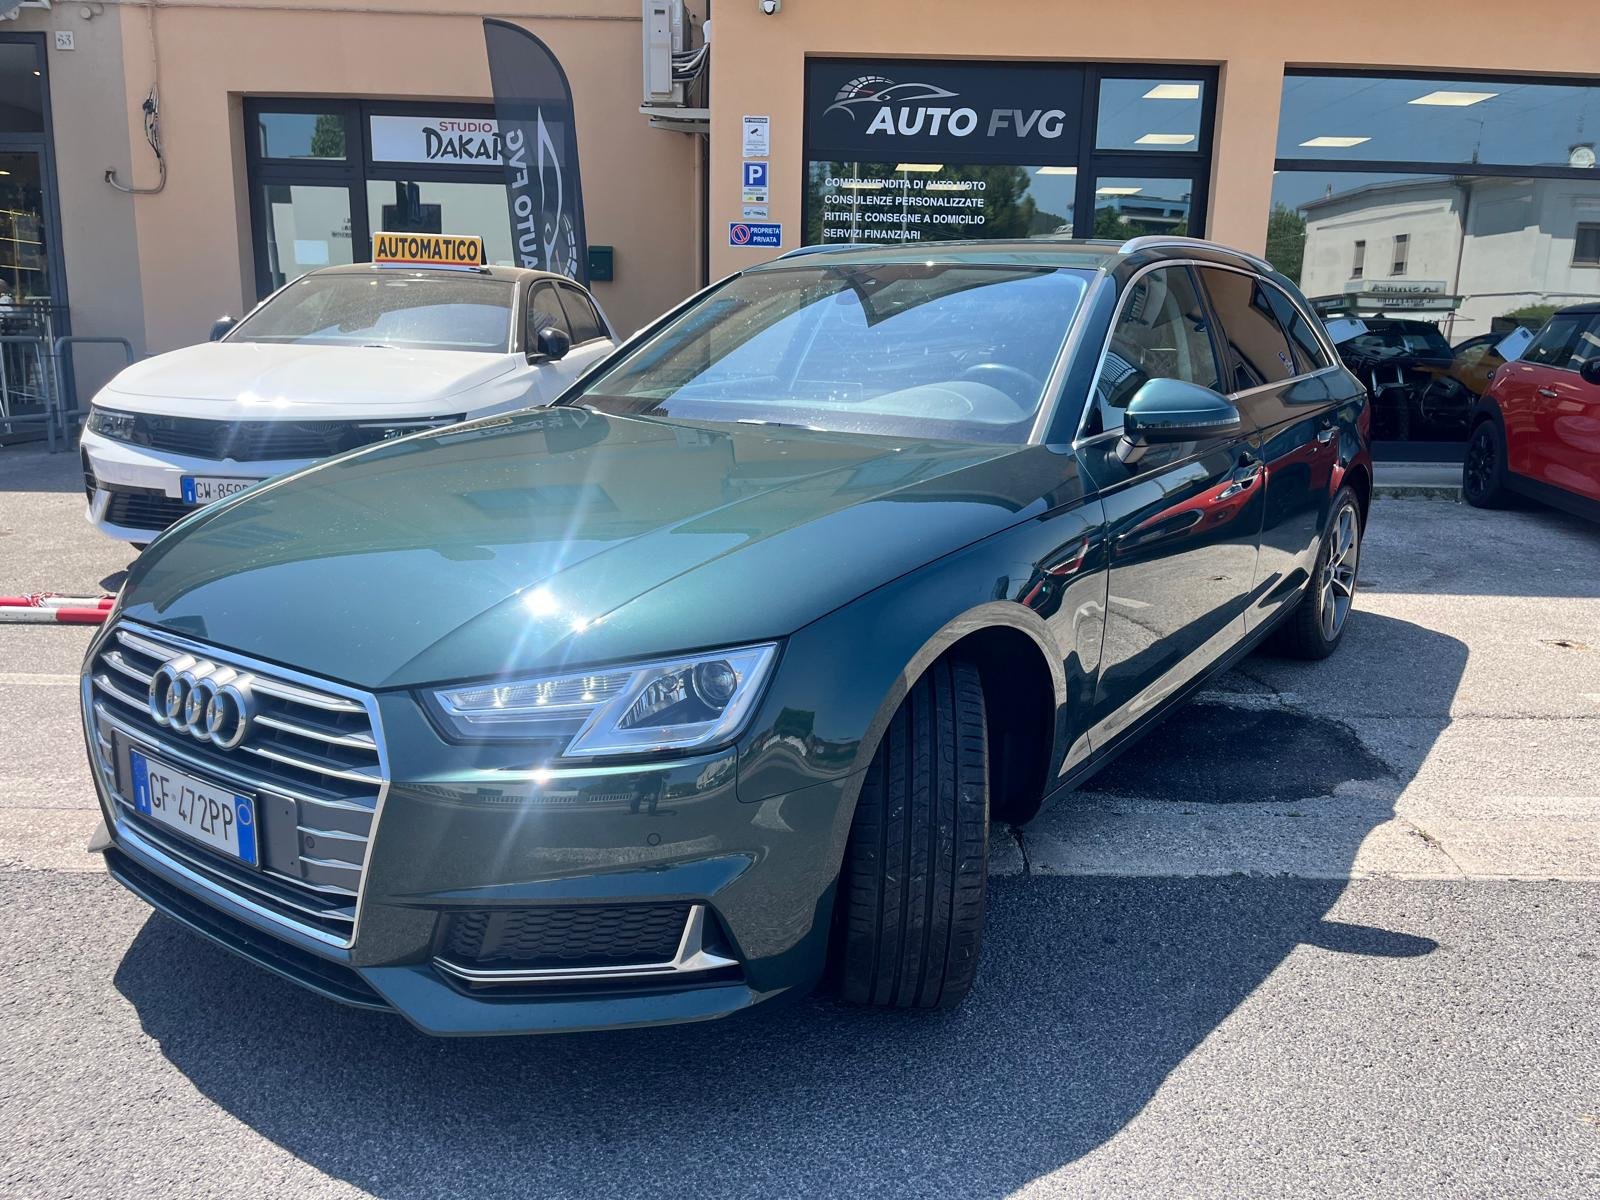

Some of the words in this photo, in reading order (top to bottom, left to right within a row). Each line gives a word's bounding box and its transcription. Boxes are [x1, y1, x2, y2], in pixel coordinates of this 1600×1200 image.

[439, 121, 493, 133] STUDIO
[866, 106, 978, 137] AUTO
[986, 109, 1066, 139] FVG
[749, 165, 763, 184] P
[825, 177, 911, 189] COMPRAVENDITA
[913, 179, 924, 189] DI
[956, 181, 986, 191] MOTO
[824, 195, 893, 205] CONSULENZE
[895, 196, 985, 208] PERSONALIZZATE
[824, 212, 853, 221] RITIRI
[855, 212, 863, 221] E
[864, 212, 922, 223] CONSEGNE
[923, 214, 931, 223] A
[933, 214, 985, 225] DOMICILIO
[823, 228, 862, 238] SERVIZI
[864, 229, 921, 240] FINANZIARI
[377, 236, 478, 261] AUTOMATICO
